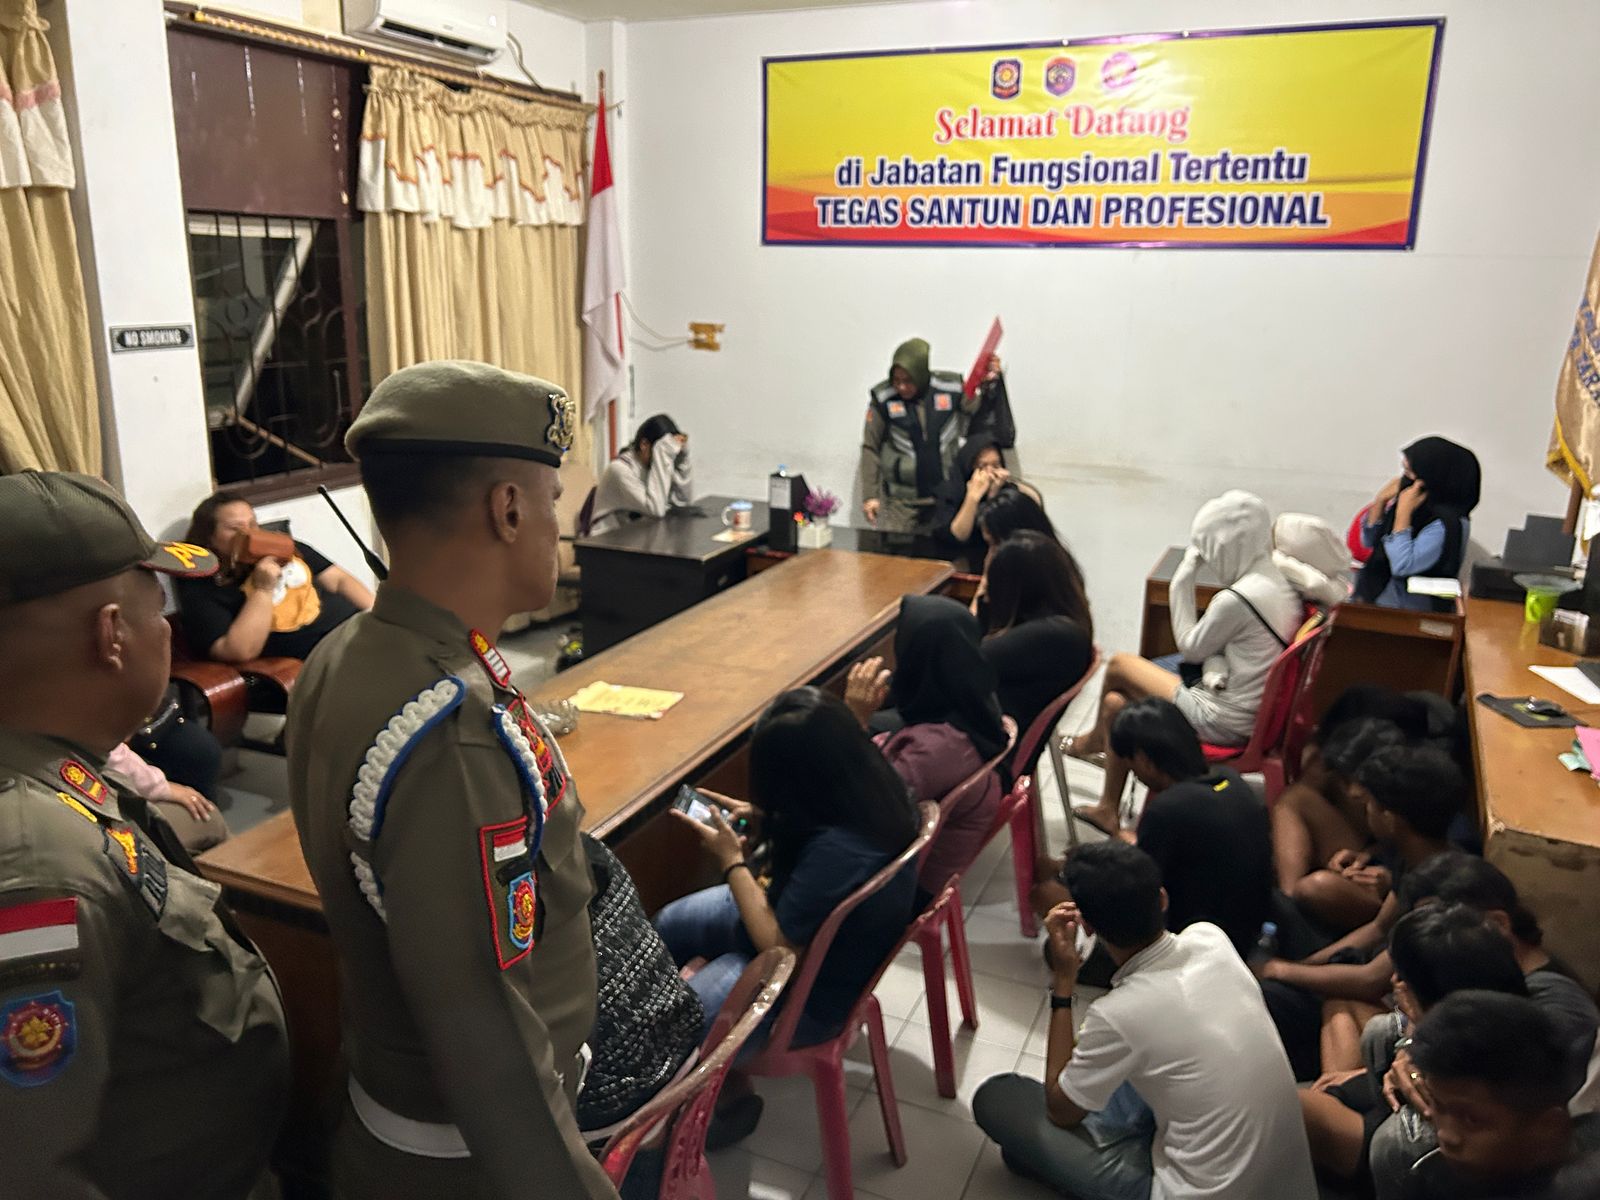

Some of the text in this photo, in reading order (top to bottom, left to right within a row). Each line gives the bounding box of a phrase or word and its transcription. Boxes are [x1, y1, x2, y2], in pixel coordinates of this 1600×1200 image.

[935, 104, 1190, 143] Selamat Datang
[837, 149, 1308, 191] di Jabatan Fungsional Tertentu
[816, 195, 1328, 226] TEGAS SANTUN DAN PROFESIONAL
[124, 328, 182, 347] NO SMOKING
